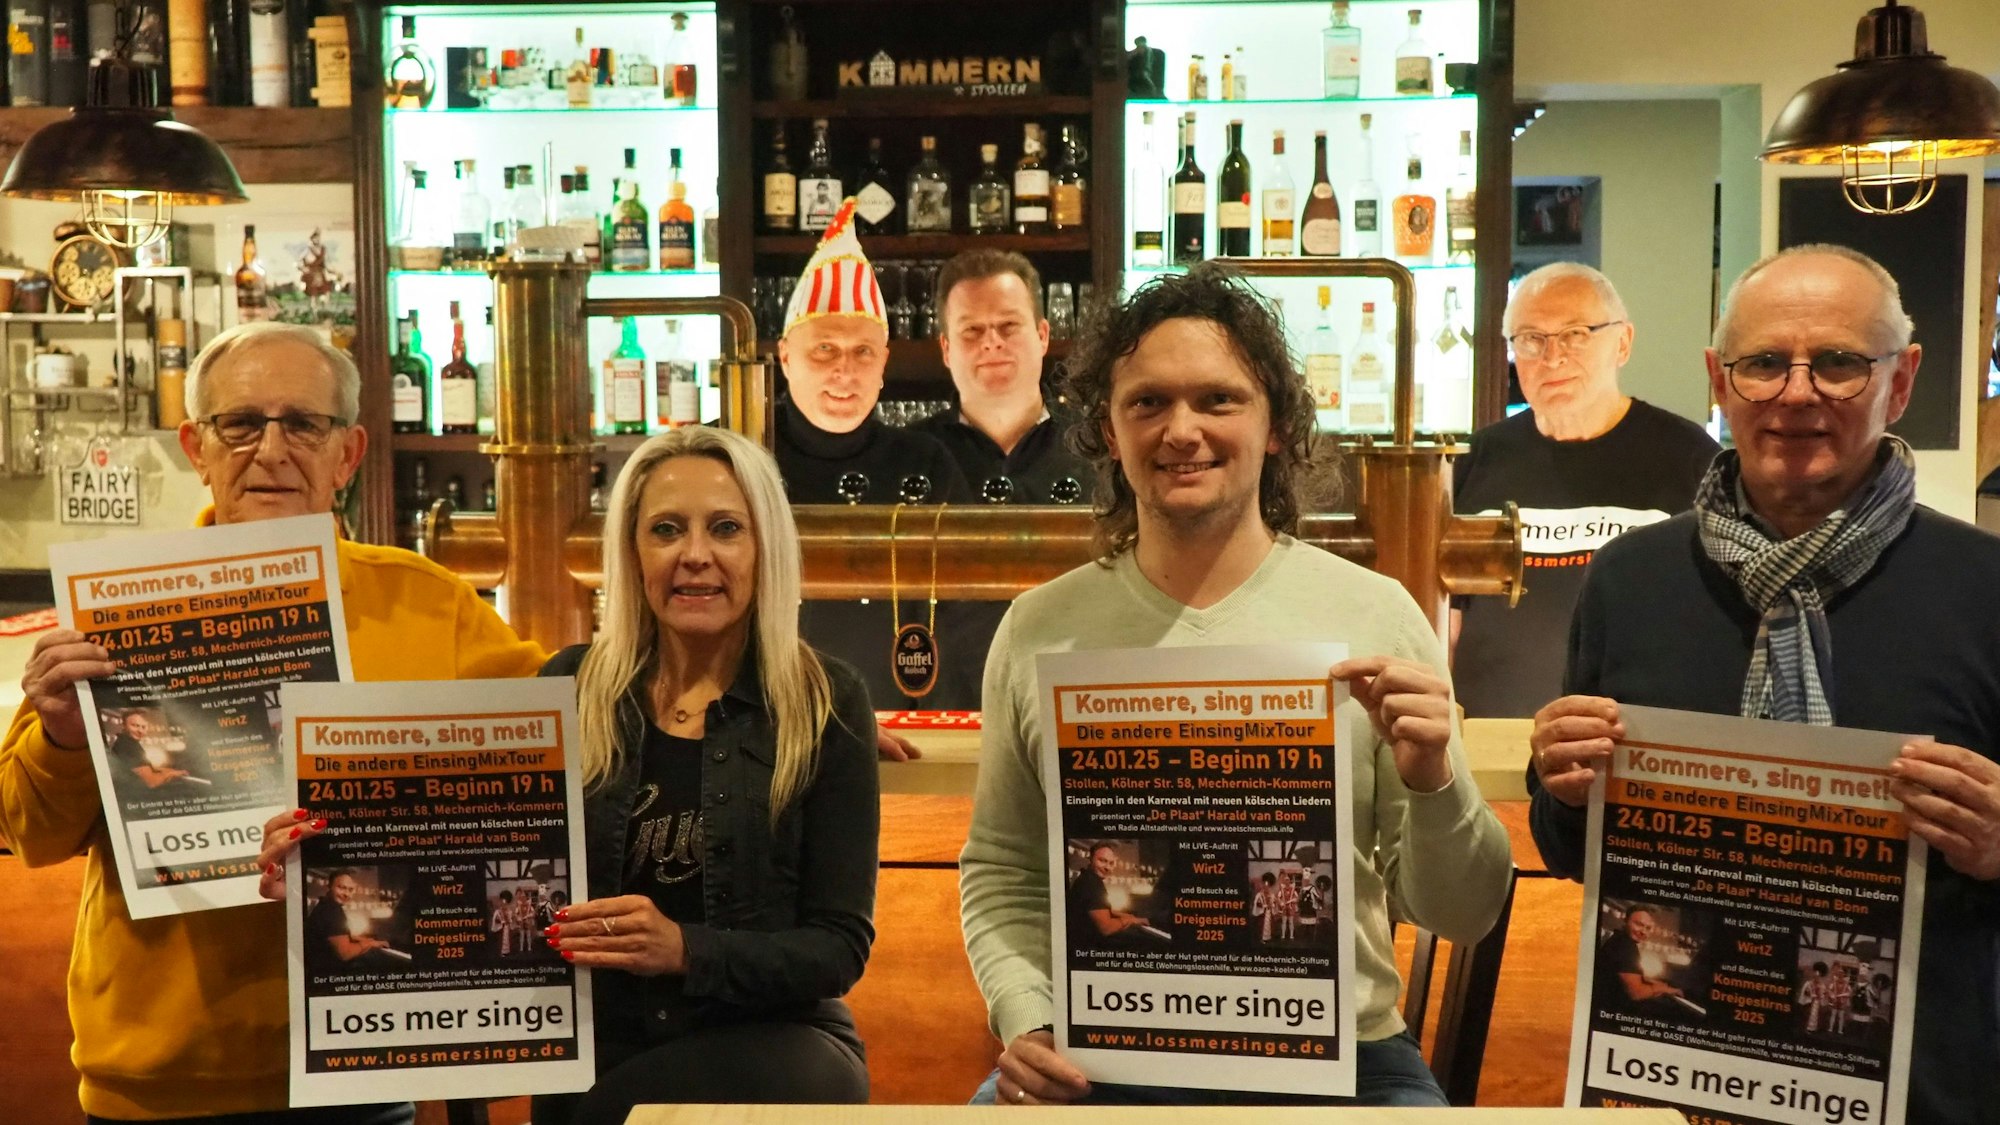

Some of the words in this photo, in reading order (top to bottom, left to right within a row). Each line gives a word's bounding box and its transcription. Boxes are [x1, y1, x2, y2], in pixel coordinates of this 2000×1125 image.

[839, 50, 1040, 86] KMMERN
[72, 472, 132, 493] FAIRY
[68, 498, 136, 519] BRIDGE
[1527, 523, 1580, 540] mer
[1585, 516, 1636, 537] sin
[1524, 552, 1592, 568] ssmersi
[89, 573, 204, 599] Kommere,
[209, 564, 254, 585] sing
[260, 555, 306, 578] met!
[92, 609, 120, 624] Die
[126, 603, 183, 620] andere
[188, 585, 309, 612] EinsingMixTour
[200, 614, 274, 637] Beginn
[279, 607, 299, 626] 19
[306, 605, 319, 623] h
[898, 652, 932, 666] Gaffel
[1075, 693, 1196, 714] Kommere,
[1204, 689, 1252, 715] sing
[1260, 688, 1313, 710] met!
[314, 725, 430, 746] Kommere,
[437, 722, 485, 746] sing
[492, 719, 544, 740] met!
[1076, 724, 1104, 740] Die
[1111, 724, 1172, 739] andere
[1179, 722, 1314, 740] EinsingMixTour
[315, 756, 341, 772] Die
[347, 756, 407, 772] andere
[413, 751, 545, 771] EinsingMixTour
[1072, 748, 1159, 770] 24.01.25
[1189, 748, 1270, 773] Beginn
[1277, 748, 1299, 768] 19
[1308, 748, 1322, 768] h
[1627, 748, 1758, 788] Kommere,
[1766, 766, 1821, 797] sing
[309, 779, 395, 801] 24.01.25
[425, 777, 503, 798] Beginn
[511, 774, 532, 793] 19
[540, 774, 554, 792] h
[1066, 795, 1113, 806] Einsingen
[1115, 795, 1124, 804] in
[1126, 795, 1144, 804] den
[1147, 795, 1191, 804] Karneval
[1193, 795, 1209, 804] mit
[1244, 795, 1289, 805] kölschen
[1292, 796, 1331, 805] Liedern
[1625, 780, 1656, 800] Die
[1662, 789, 1729, 809] andere
[1735, 794, 1888, 829] EinsingMixTour
[144, 831, 209, 854] Loss
[217, 825, 262, 845] me
[1617, 806, 1711, 838] 24.01.25
[1744, 823, 1834, 855] Beginn
[1843, 836, 1868, 858] 19
[1877, 840, 1892, 862] h
[1192, 862, 1224, 874] WirtZ
[1174, 897, 1244, 909] Kommerner
[414, 918, 483, 928] Kommerner
[1174, 913, 1246, 926] Dreigestirns
[1196, 929, 1224, 941] 2025
[437, 947, 464, 958] 2025
[325, 1009, 394, 1034] Loss
[405, 1008, 468, 1030] mer
[476, 999, 563, 1032] singe
[1086, 984, 1153, 1012] Loss
[1164, 993, 1226, 1015] mer
[1236, 988, 1324, 1026] singe
[326, 1043, 563, 1066] www.lossmersinge.de
[1087, 1032, 1324, 1054] www.lossmersinge.de
[1606, 1047, 1679, 1086] Loss
[1690, 1069, 1761, 1100] mer
[1770, 1078, 1869, 1124] singe
